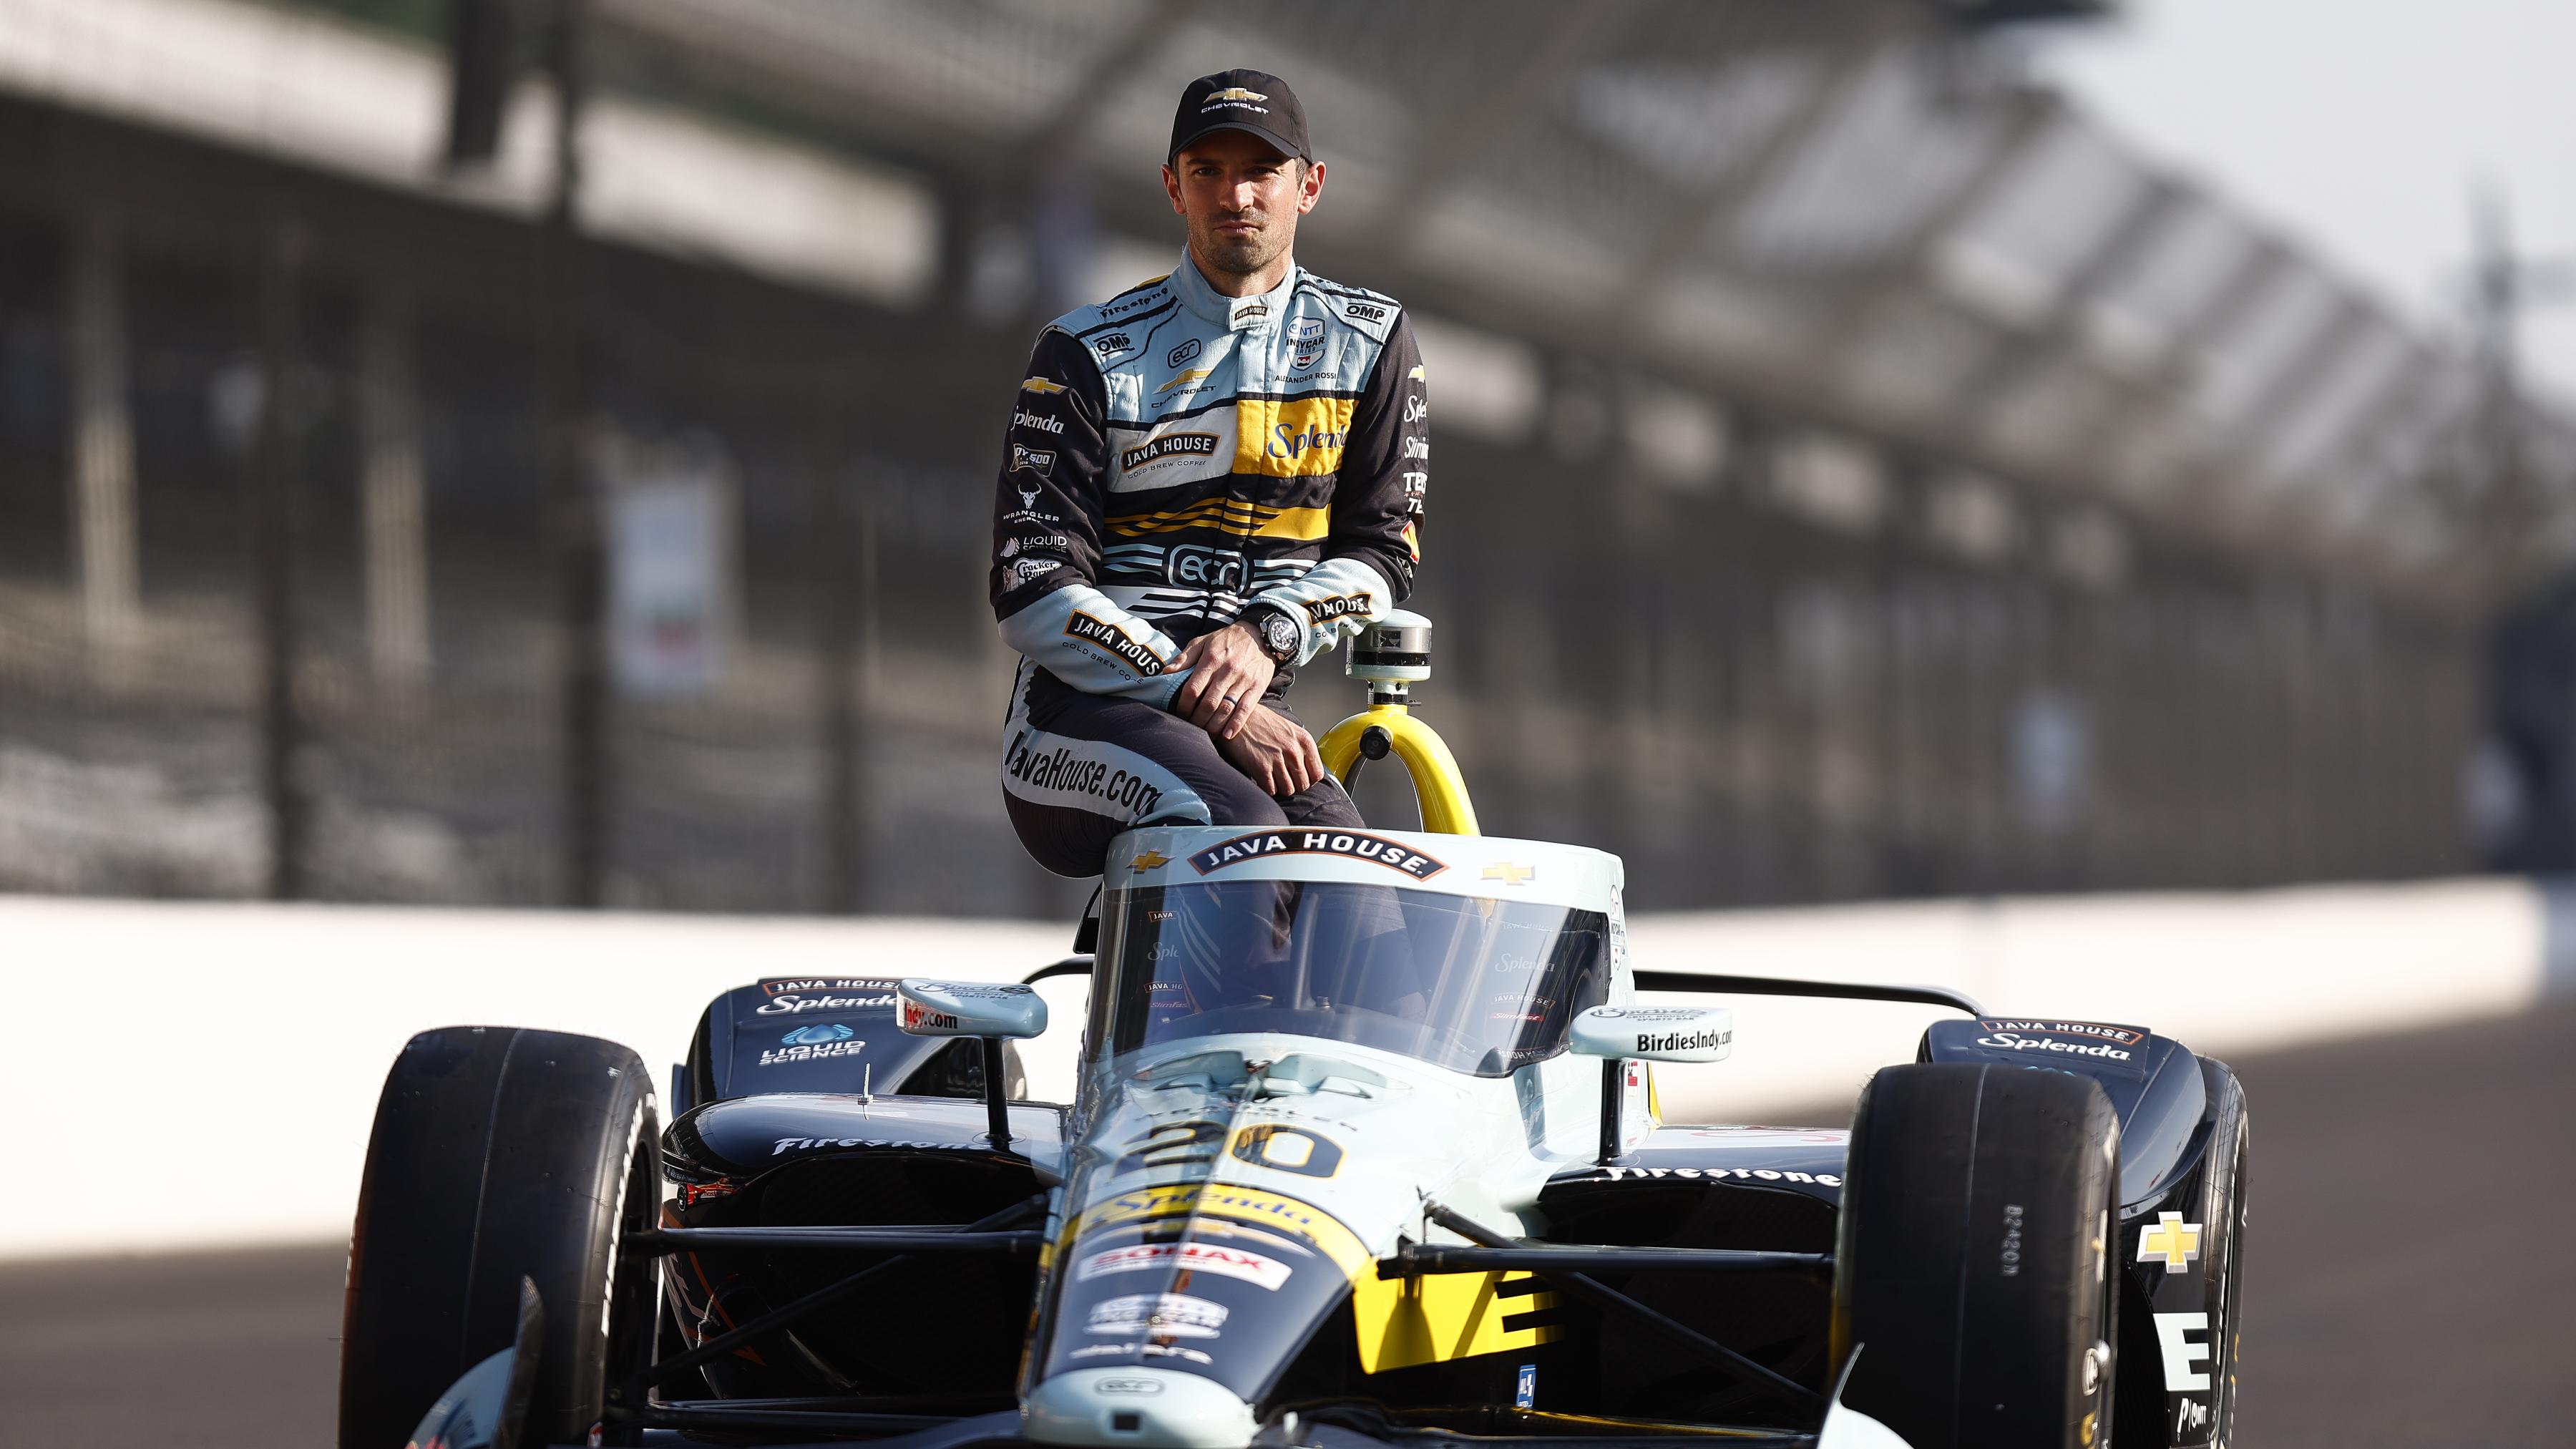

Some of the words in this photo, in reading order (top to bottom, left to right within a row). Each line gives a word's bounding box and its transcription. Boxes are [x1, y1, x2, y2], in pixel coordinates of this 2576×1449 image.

[1201, 102, 1269, 114] CHEVROLET
[1100, 286, 1169, 319] Firestone
[1235, 307, 1249, 319] JAVA
[1249, 306, 1267, 316] HOUSE
[1346, 305, 1385, 320] OMP
[1096, 336, 1131, 352] OMP
[1274, 372, 1313, 384] ALEXANDER
[1151, 385, 1216, 408] CHEVROLET
[1010, 406, 1065, 435] plenda
[1030, 454, 1050, 465] 500
[1126, 447, 1158, 467] JAVA
[1128, 468, 1148, 479] COLD
[1151, 462, 1174, 472] BREW
[1003, 510, 1060, 522] WRANGLER
[1023, 535, 1068, 546] LIQUID
[1016, 560, 1055, 579] Cracker
[1062, 641, 1088, 655] COLD
[1091, 652, 1117, 669] BREW
[1074, 618, 1116, 645] JAVA
[1116, 638, 1160, 675] HOUS
[1209, 834, 1287, 867] JAVA
[777, 980, 826, 991] JAVA
[835, 979, 899, 989] HOUS
[1494, 994, 1514, 1002] JAVA
[1517, 995, 1550, 1006] HOUSE
[1996, 1021, 2046, 1030] JAVA
[761, 1040, 866, 1058] LIQUID
[1976, 1033, 2131, 1061] Splenda
[758, 1047, 862, 1066] SCIENCE
[772, 1136, 996, 1156] Firestone
[1107, 1120, 1347, 1184] 20
[1597, 1166, 1843, 1187] Firestone
